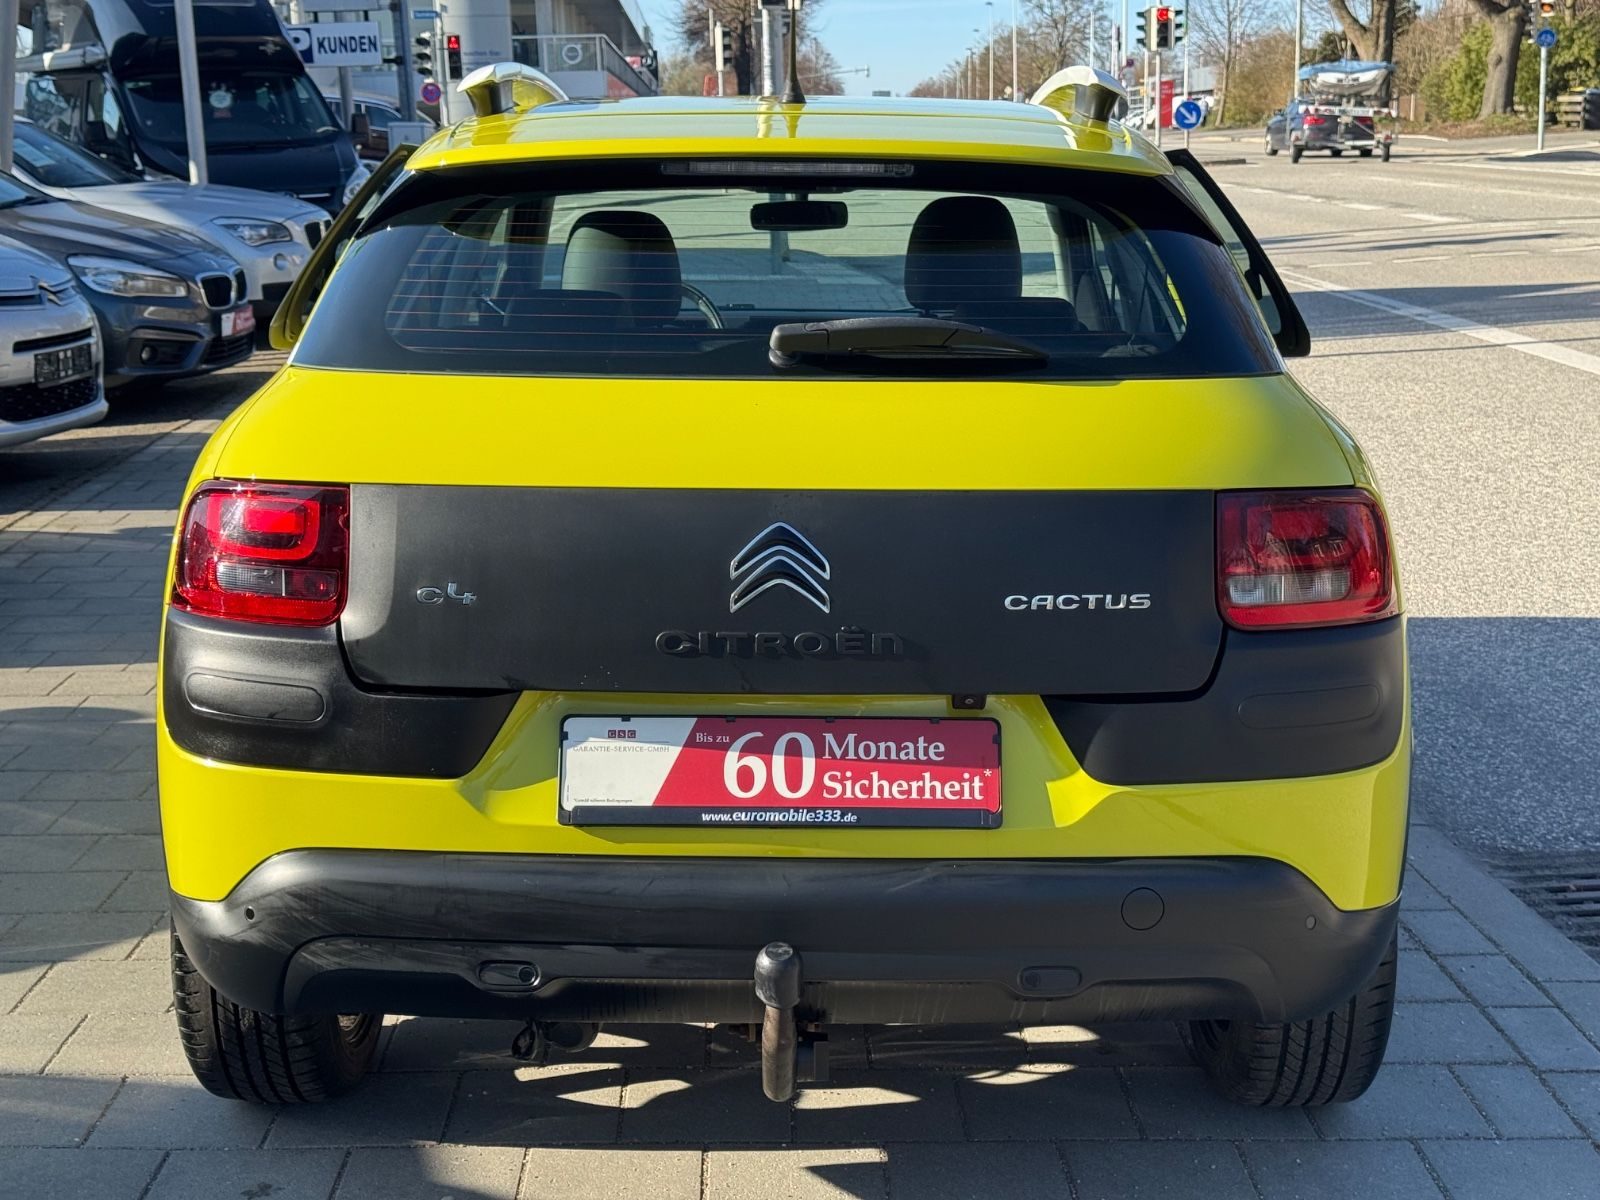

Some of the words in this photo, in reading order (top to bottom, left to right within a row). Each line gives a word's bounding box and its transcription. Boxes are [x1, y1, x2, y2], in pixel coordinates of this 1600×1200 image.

[316, 35, 378, 54] KUNDEN
[416, 582, 477, 605] C4
[1004, 594, 1151, 610] CACTUS
[608, 730, 636, 738] GSG
[695, 732, 714, 743] Bis
[716, 735, 730, 743] zu
[822, 733, 945, 761] Monate
[723, 731, 816, 799] 60
[701, 808, 858, 823] www.euromobile333.de
